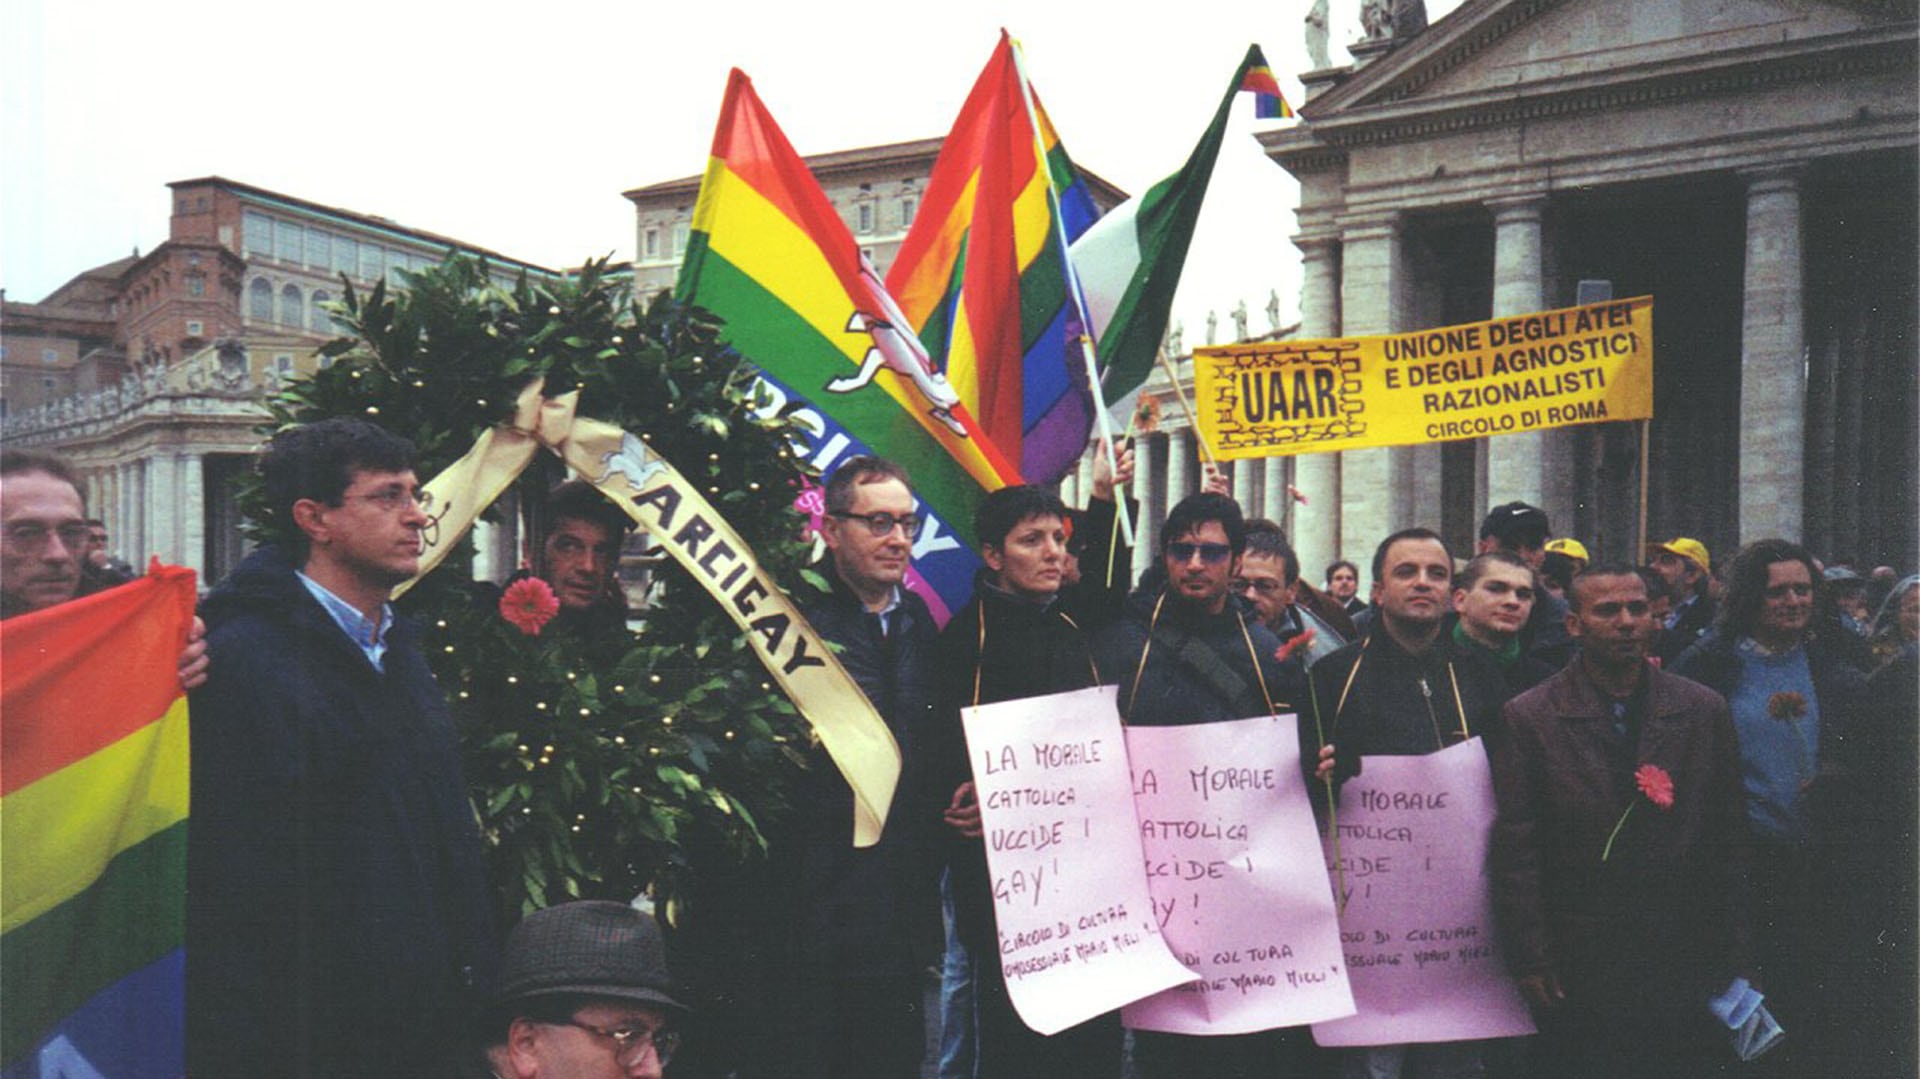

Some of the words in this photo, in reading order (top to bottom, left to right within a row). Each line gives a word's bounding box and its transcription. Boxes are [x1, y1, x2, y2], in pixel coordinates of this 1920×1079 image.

[1384, 327, 1481, 361] UNIONE
[1489, 307, 1566, 347] DEGLI
[1575, 303, 1632, 333] ATEI
[1386, 368, 1400, 388] E
[1408, 357, 1483, 387] DEGLI
[1492, 332, 1637, 376] AGNOSTICI
[1242, 368, 1337, 423] UAAR
[1424, 367, 1605, 413] RAZIONALISTI
[1426, 413, 1515, 439] CIRCOLO
[1522, 410, 1542, 428] DI
[1548, 399, 1608, 424] ROMA
[631, 484, 826, 675] ARCIGAY
[985, 745, 1018, 775] LA
[1033, 740, 1102, 771] MORALE
[987, 788, 1077, 811] CATTOLICA
[1189, 765, 1275, 800] MORALE
[1361, 789, 1450, 812] MORALE
[992, 822, 1064, 851] UCCIDE
[1142, 817, 1248, 841] ATTOLICA
[1146, 857, 1225, 881] CCIDE
[1406, 926, 1479, 942] CULTURA
